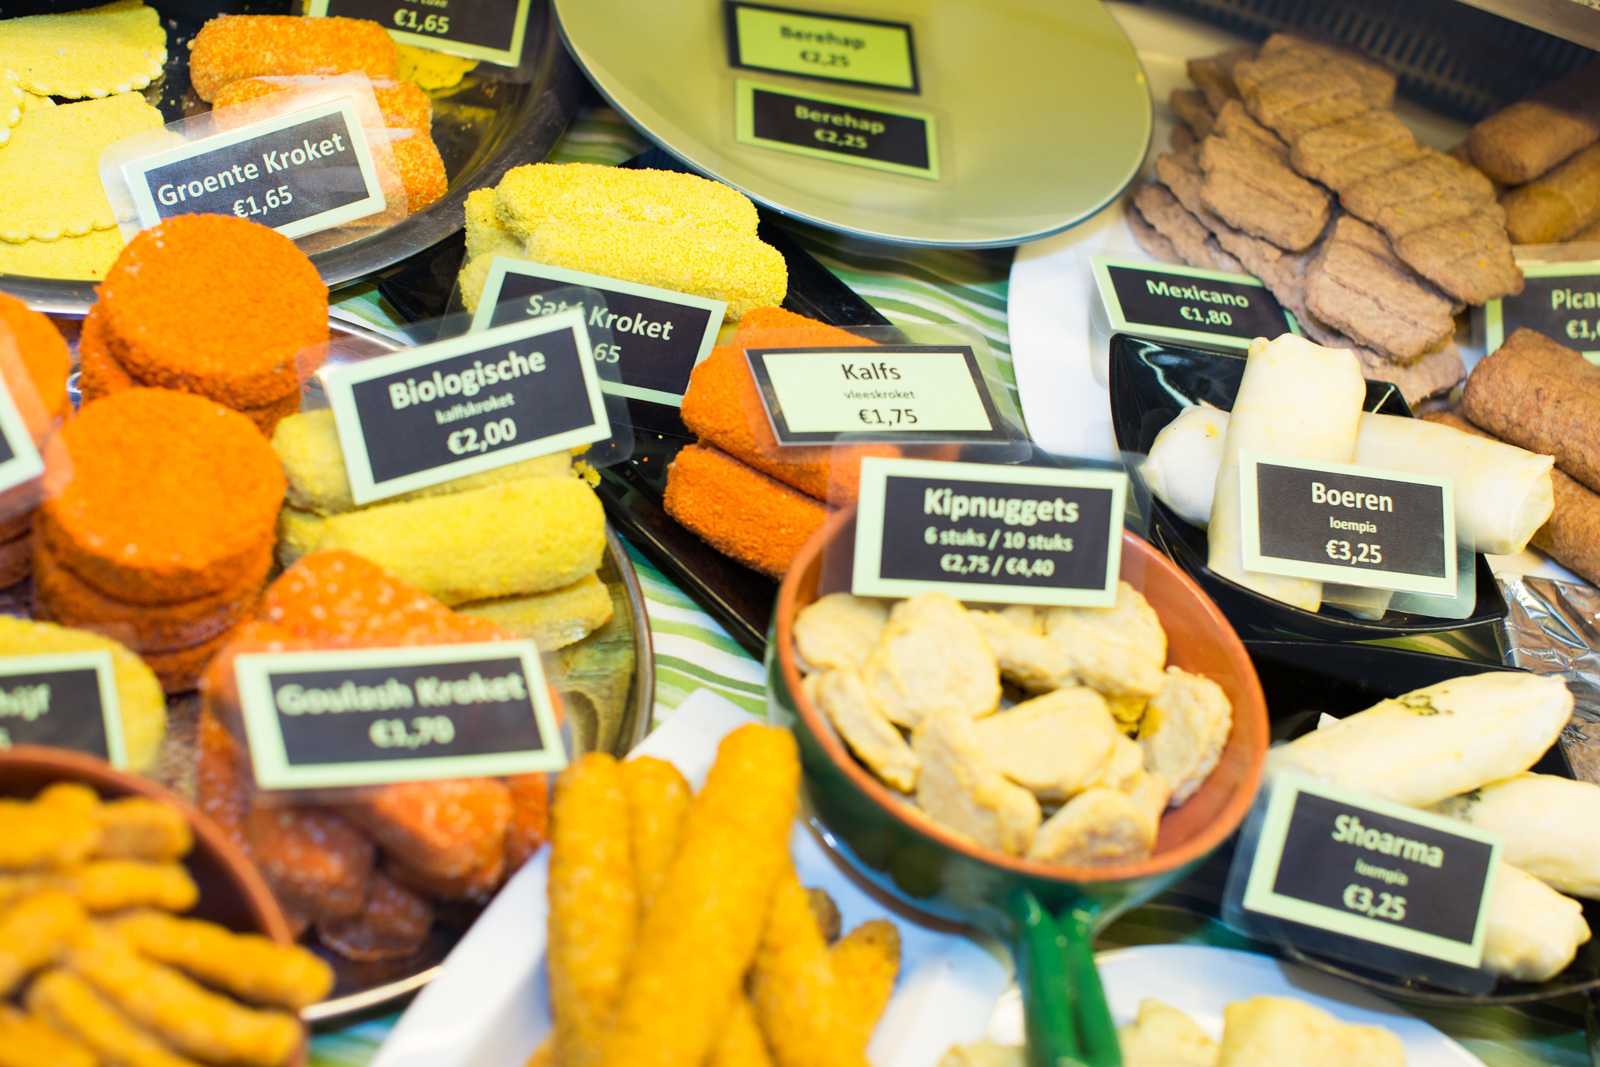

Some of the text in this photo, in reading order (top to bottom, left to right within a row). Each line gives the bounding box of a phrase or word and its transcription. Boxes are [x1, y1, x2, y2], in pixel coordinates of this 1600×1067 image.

[393, 8, 450, 34] €1,65
[780, 25, 866, 51] Berehap
[799, 51, 850, 67] €2,25
[794, 104, 885, 135] Berehap
[814, 128, 868, 149] €2,25
[157, 133, 346, 207] Groente Kroket
[232, 184, 293, 219] €1,65
[1145, 279, 1250, 308] Mexicano
[588, 305, 674, 341] Kroket
[1179, 305, 1233, 326] €1,80
[388, 350, 547, 410] Biologische
[841, 362, 901, 380] Kalfs
[434, 392, 516, 425] kalfskroket
[843, 390, 916, 400] vleeskroket
[858, 408, 918, 427] €1,75
[446, 417, 517, 455] €2,00
[923, 487, 1080, 527] Kipnuggets
[1311, 481, 1393, 513] Boeren
[924, 526, 938, 545] 6
[939, 528, 987, 548] stuks
[1002, 531, 1026, 550] 10
[1027, 533, 1074, 552] stuks
[1329, 516, 1377, 534] loempia
[940, 553, 990, 575] €2,75
[1005, 557, 1055, 579] €4,40
[1325, 539, 1383, 565] €3,25
[275, 671, 528, 716] Goulash Kroket
[368, 715, 456, 750] €1,70
[1331, 813, 1445, 869] Shoarma
[1354, 857, 1409, 887] loempia
[1342, 883, 1408, 921] €3,25
